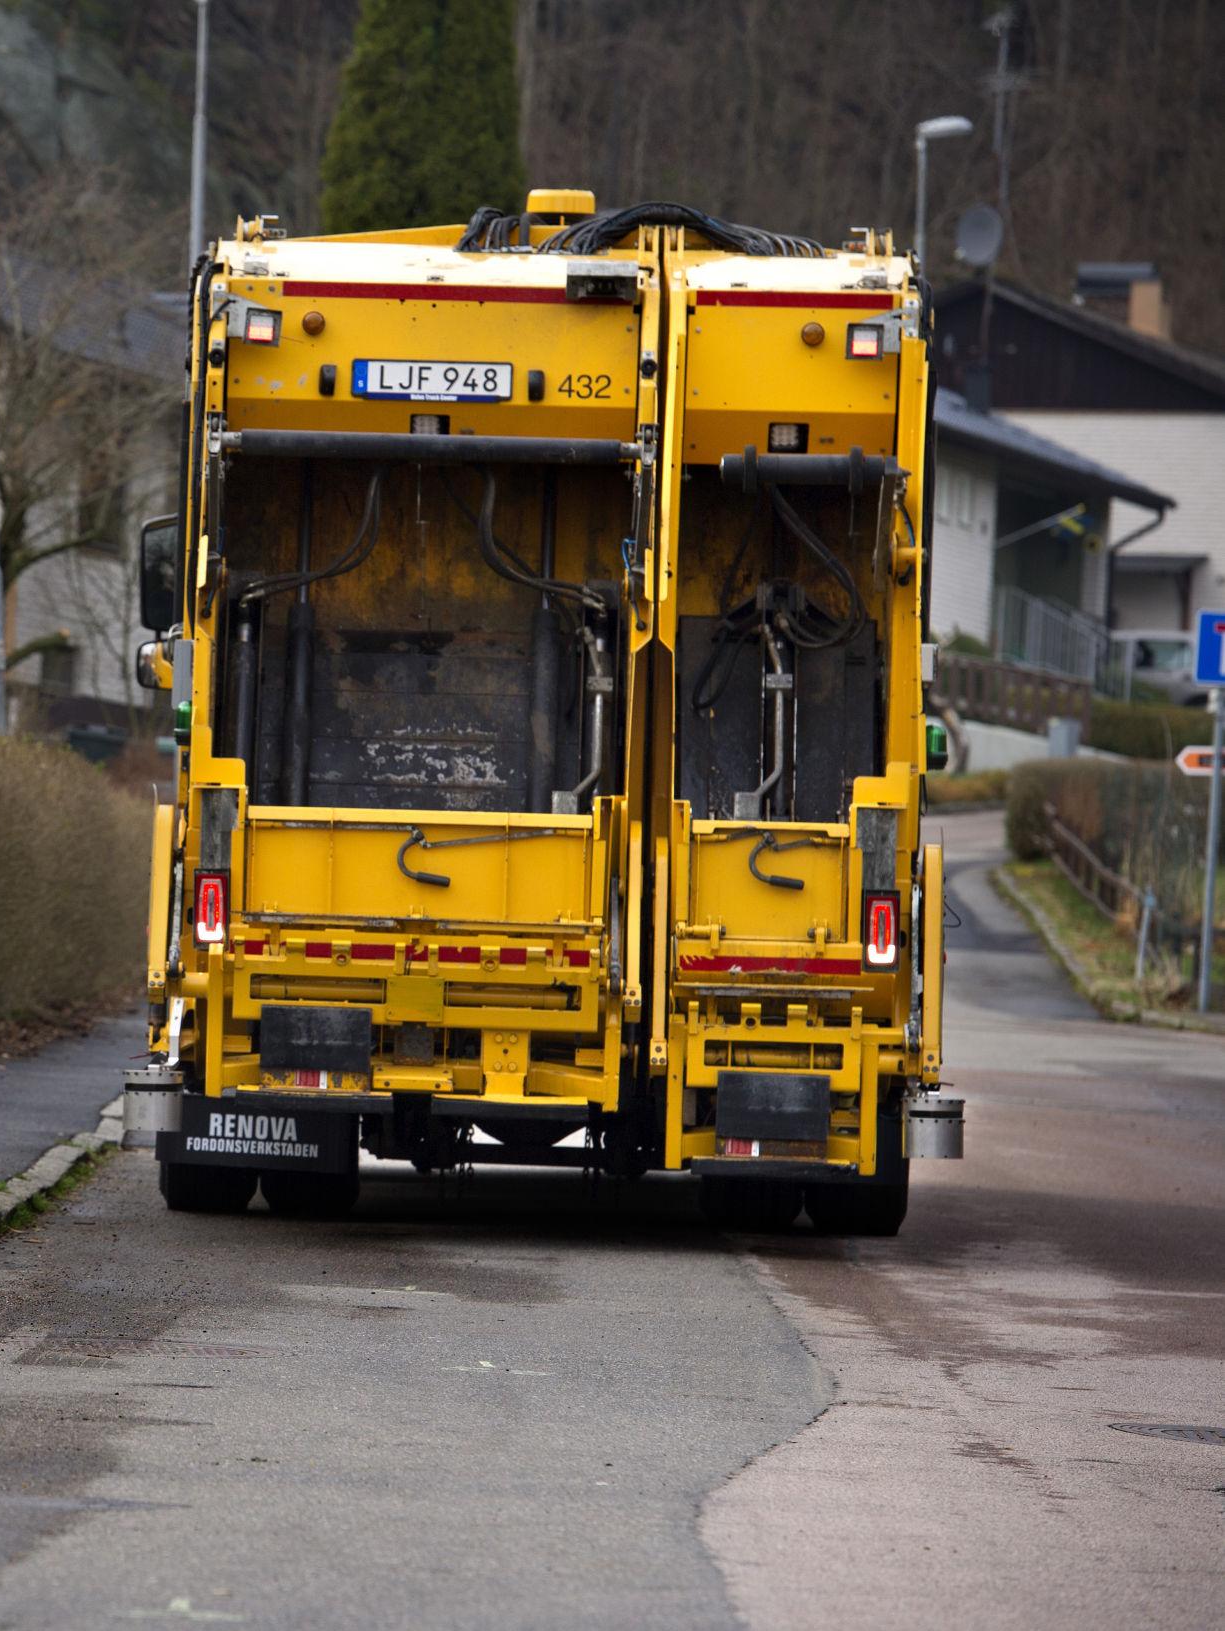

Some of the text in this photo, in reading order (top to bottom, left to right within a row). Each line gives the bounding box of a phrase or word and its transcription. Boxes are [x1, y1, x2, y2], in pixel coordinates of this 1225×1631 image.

[380, 364, 498, 392] LJF 948
[558, 374, 611, 399] 432
[209, 1112, 297, 1141] RENOVA
[186, 1137, 319, 1158] FORDONSVERKSTADEN
